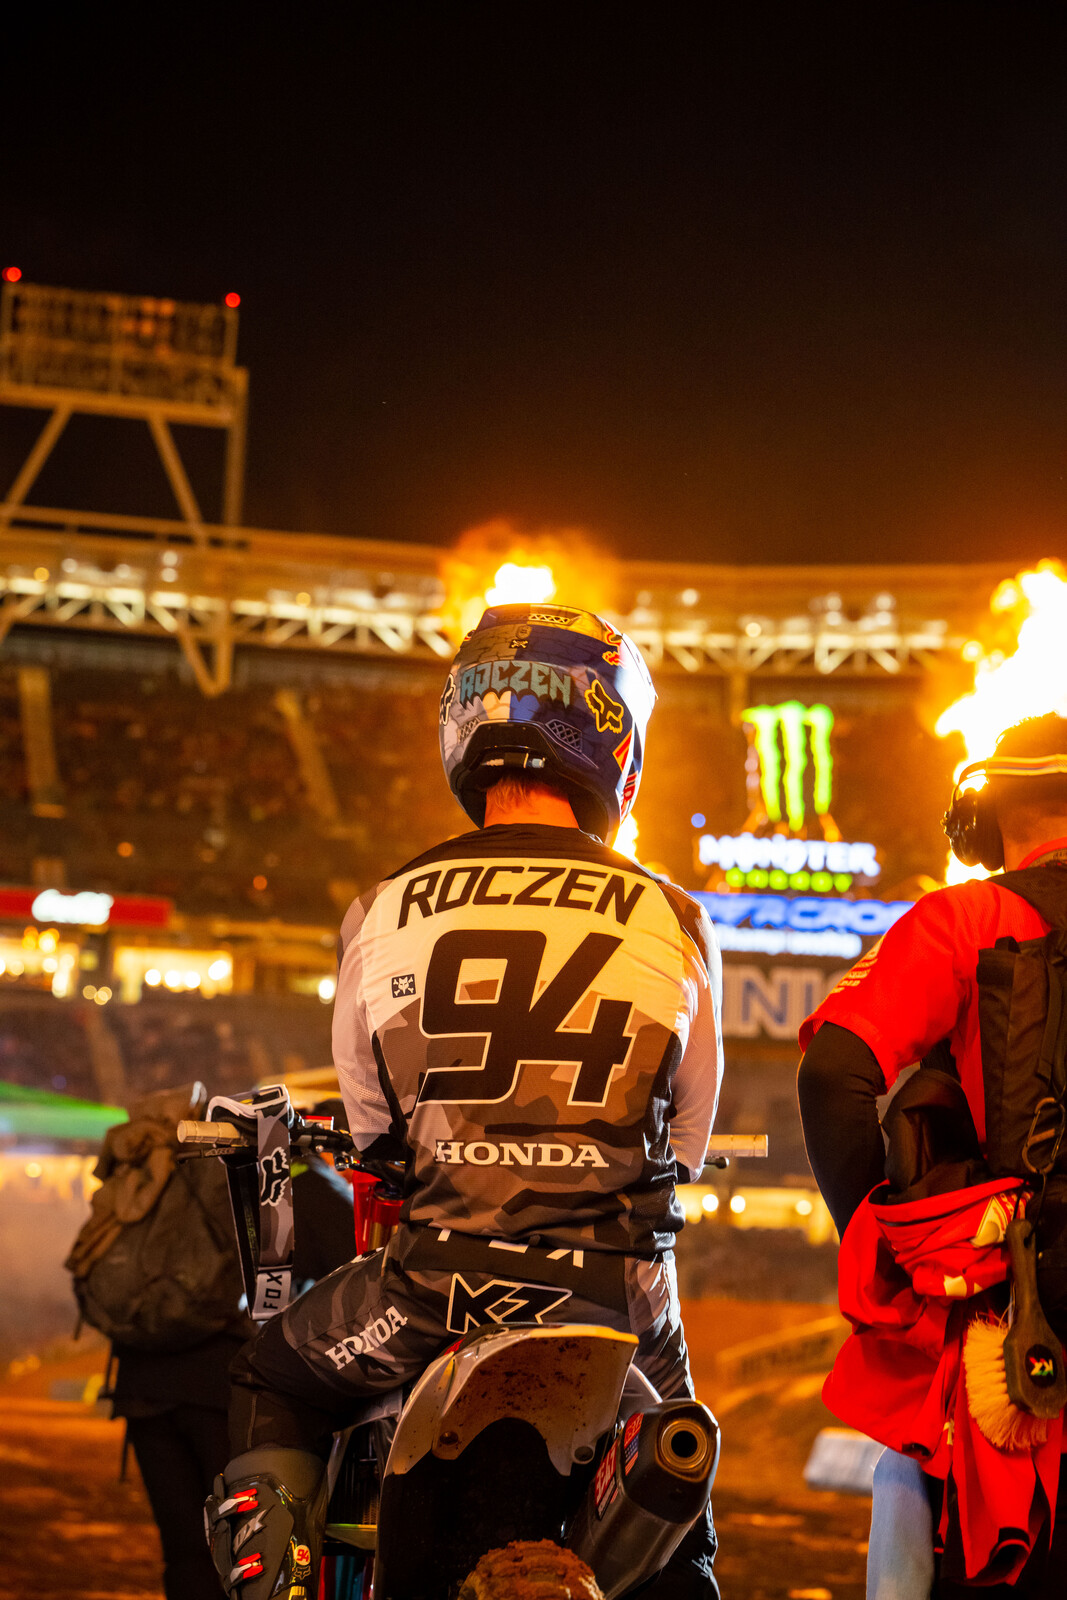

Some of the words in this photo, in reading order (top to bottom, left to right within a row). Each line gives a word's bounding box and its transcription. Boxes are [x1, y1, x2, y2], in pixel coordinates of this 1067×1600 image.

[459, 661, 571, 709] ROCZEN
[397, 866, 646, 930] ROCZEN
[418, 929, 637, 1107] 94
[435, 1139, 610, 1168] HONDA
[263, 1271, 283, 1310] FOX
[324, 1305, 408, 1371] HONDA
